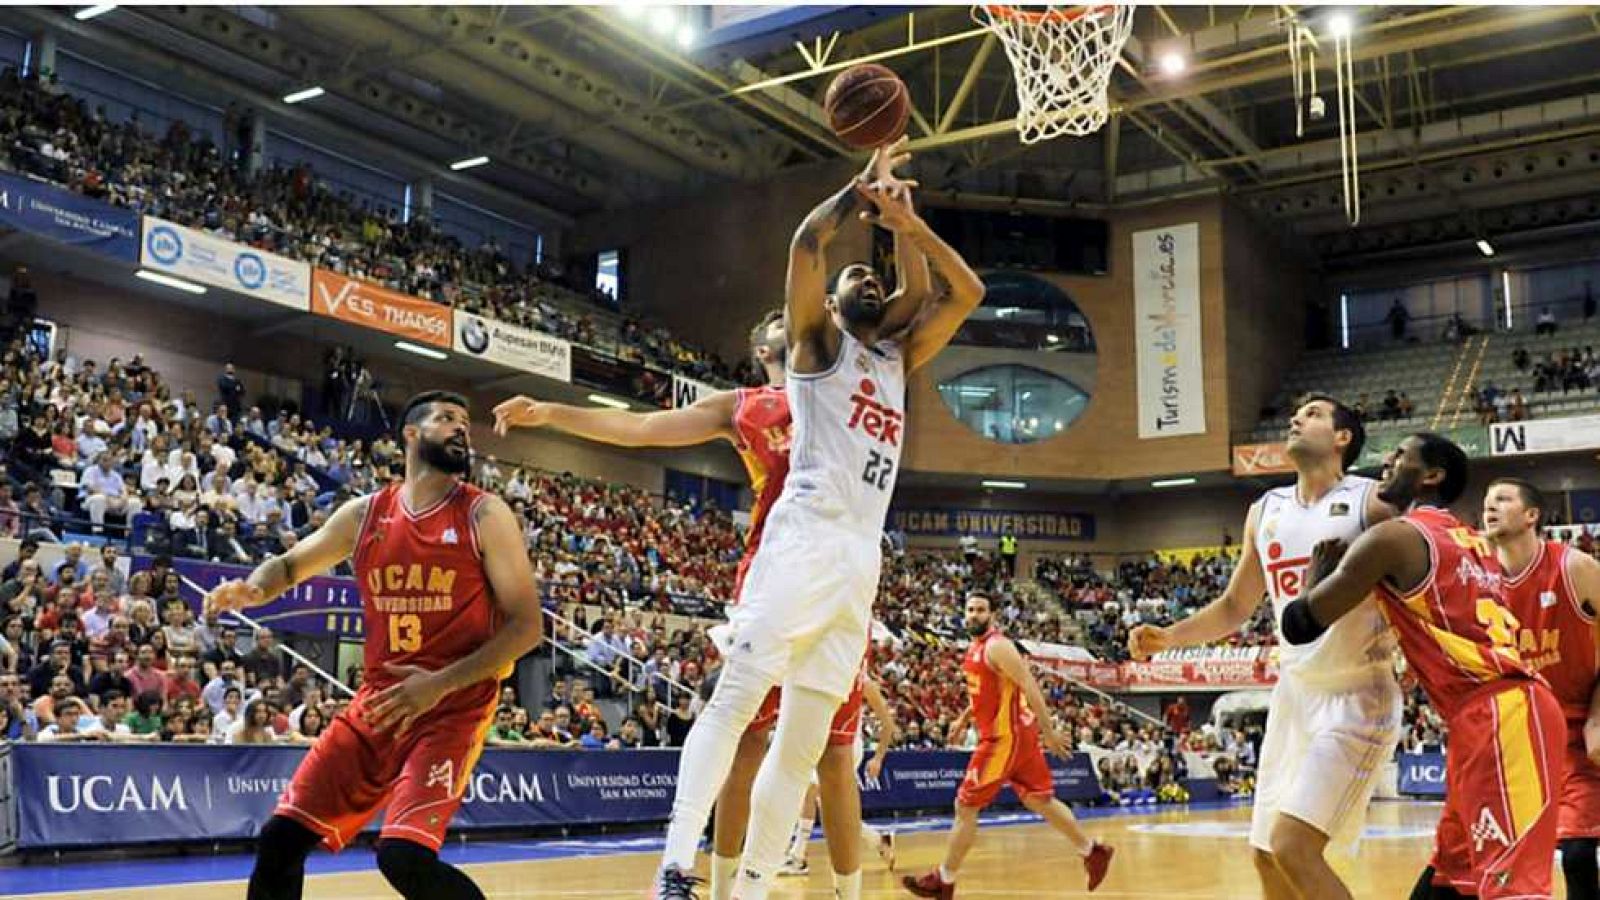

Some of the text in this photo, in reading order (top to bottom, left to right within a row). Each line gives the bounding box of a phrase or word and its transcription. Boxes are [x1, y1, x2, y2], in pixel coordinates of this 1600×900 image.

[862, 451, 893, 490] 22
[957, 511, 1082, 536] UNIVERSIDAD
[368, 564, 456, 593] UCAM
[390, 614, 422, 653] 13
[47, 774, 188, 813] UCAM
[567, 773, 640, 788] UNIVERSIDAD
[600, 787, 667, 799] SAN ANTONIO
